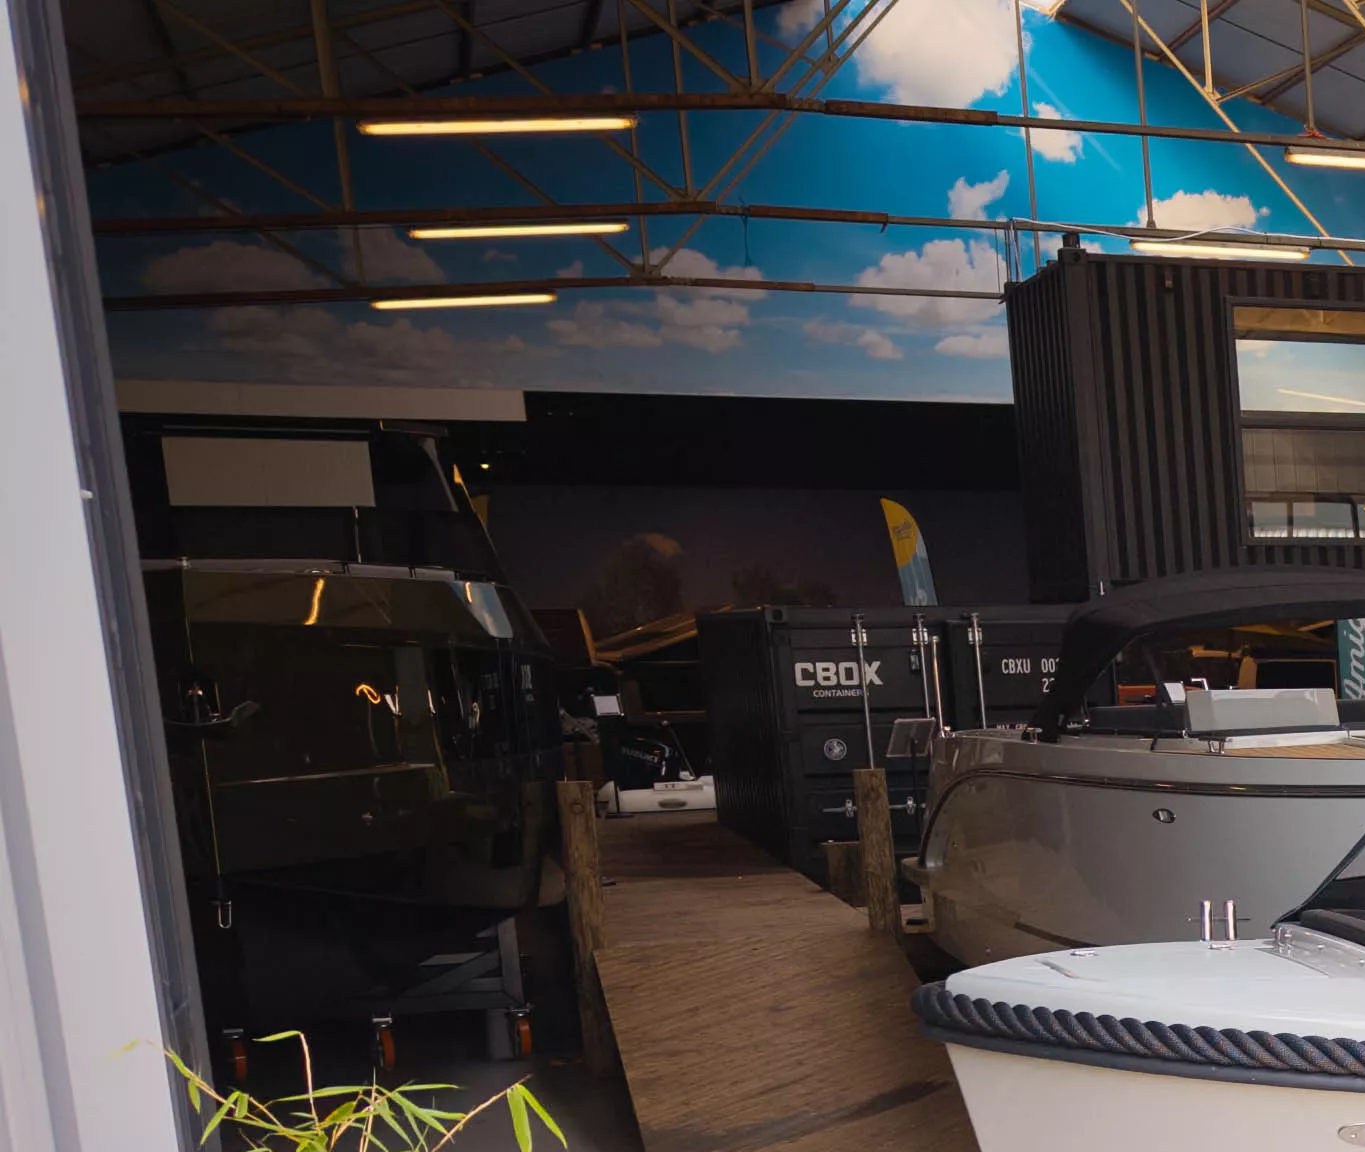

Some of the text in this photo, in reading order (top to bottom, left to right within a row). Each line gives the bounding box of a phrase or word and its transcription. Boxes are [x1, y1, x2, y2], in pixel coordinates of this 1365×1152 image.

[794, 661, 884, 687] CBOX
[1001, 658, 1031, 674] CBXU
[813, 688, 870, 697] CONTAINER
